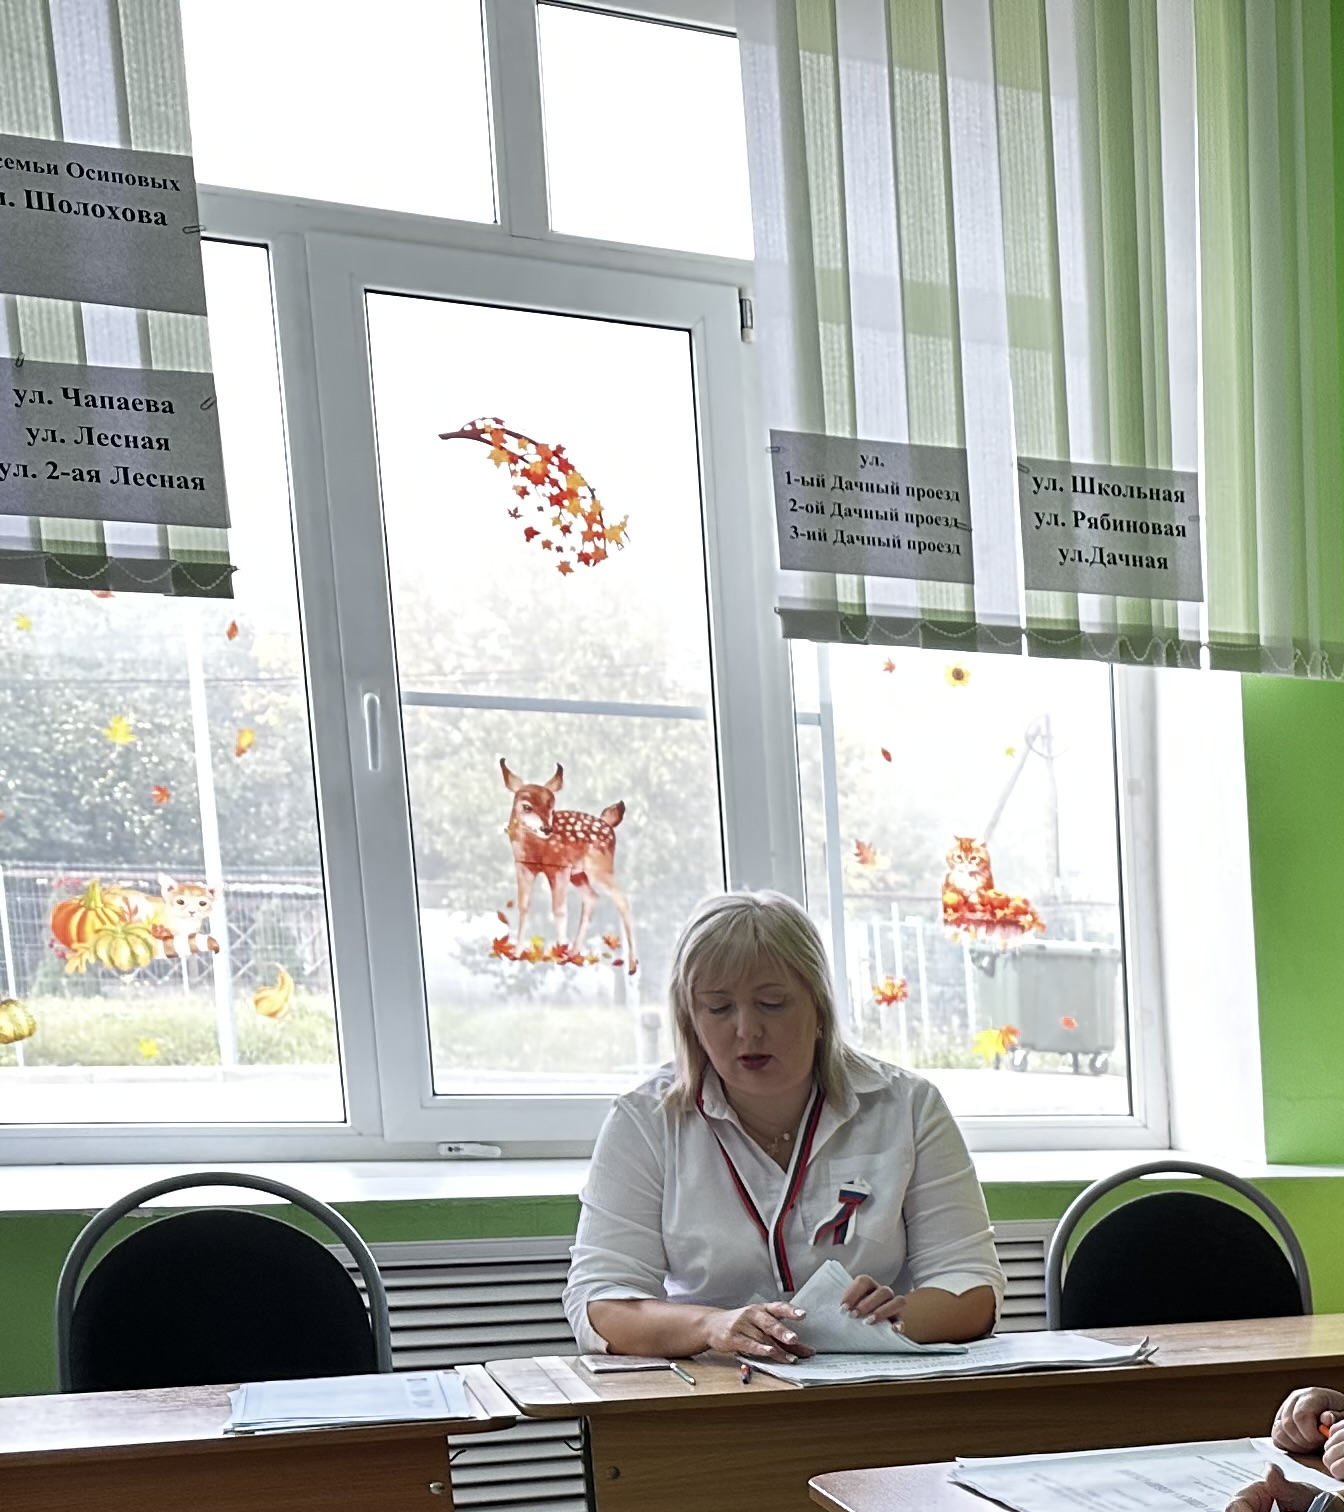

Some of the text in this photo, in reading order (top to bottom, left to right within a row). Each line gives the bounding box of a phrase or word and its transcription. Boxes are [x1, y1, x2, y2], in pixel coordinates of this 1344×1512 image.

[66, 162, 181, 192] Осиповых
[24, 189, 168, 226] Шолохова
[12, 387, 175, 414] ул. Чапаева
[26, 426, 171, 451] ул. Лесная
[860, 451, 885, 468] ул.
[0, 461, 205, 490] ул. 2-ая Лесная
[785, 471, 960, 502] 1-ый Дачный проезд
[1032, 474, 1185, 504] ул. Школьная
[789, 498, 959, 529] 2-ой Дачный проезд
[1034, 510, 1187, 538] ул. Рябиновая
[790, 525, 961, 557] 3-ий Дачный проезд
